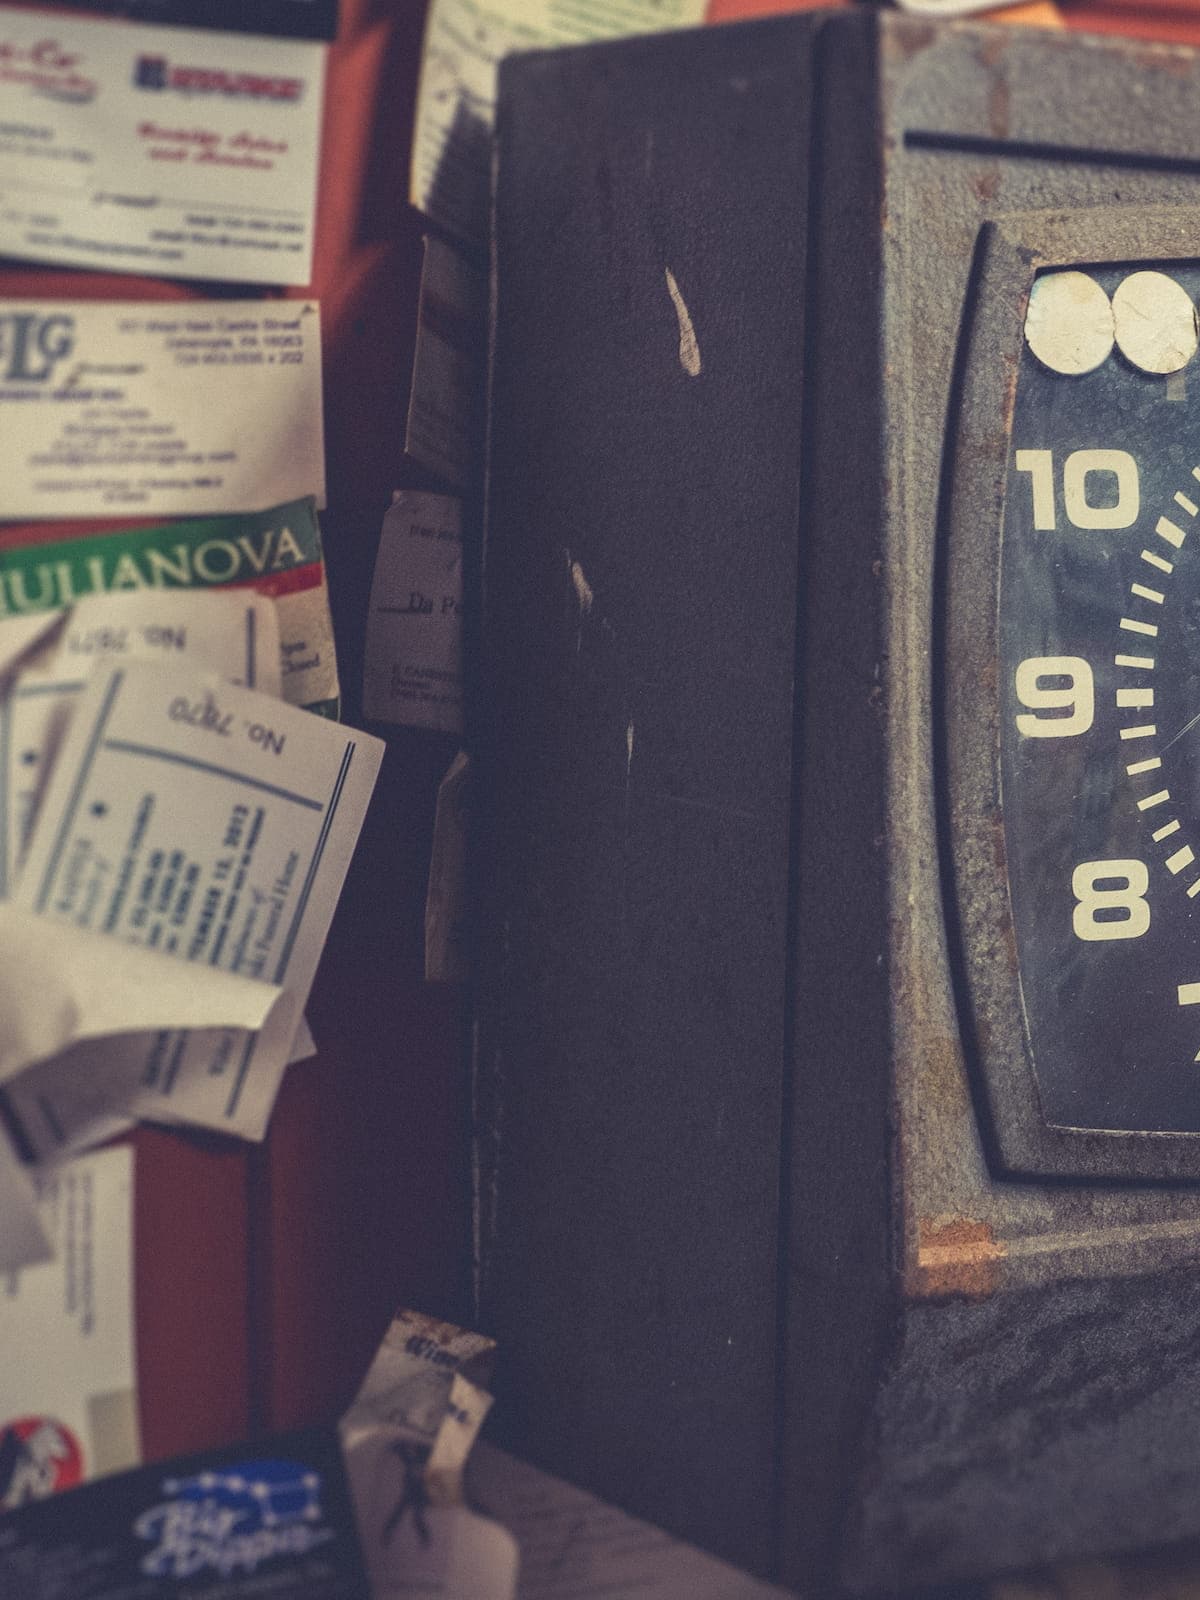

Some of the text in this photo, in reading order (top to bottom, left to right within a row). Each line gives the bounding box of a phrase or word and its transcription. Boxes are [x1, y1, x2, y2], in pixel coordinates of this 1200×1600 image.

[0, 313, 76, 383] LG
[1016, 449, 1140, 530] 10
[1015, 656, 1094, 740] 9
[1072, 860, 1150, 941] 8
